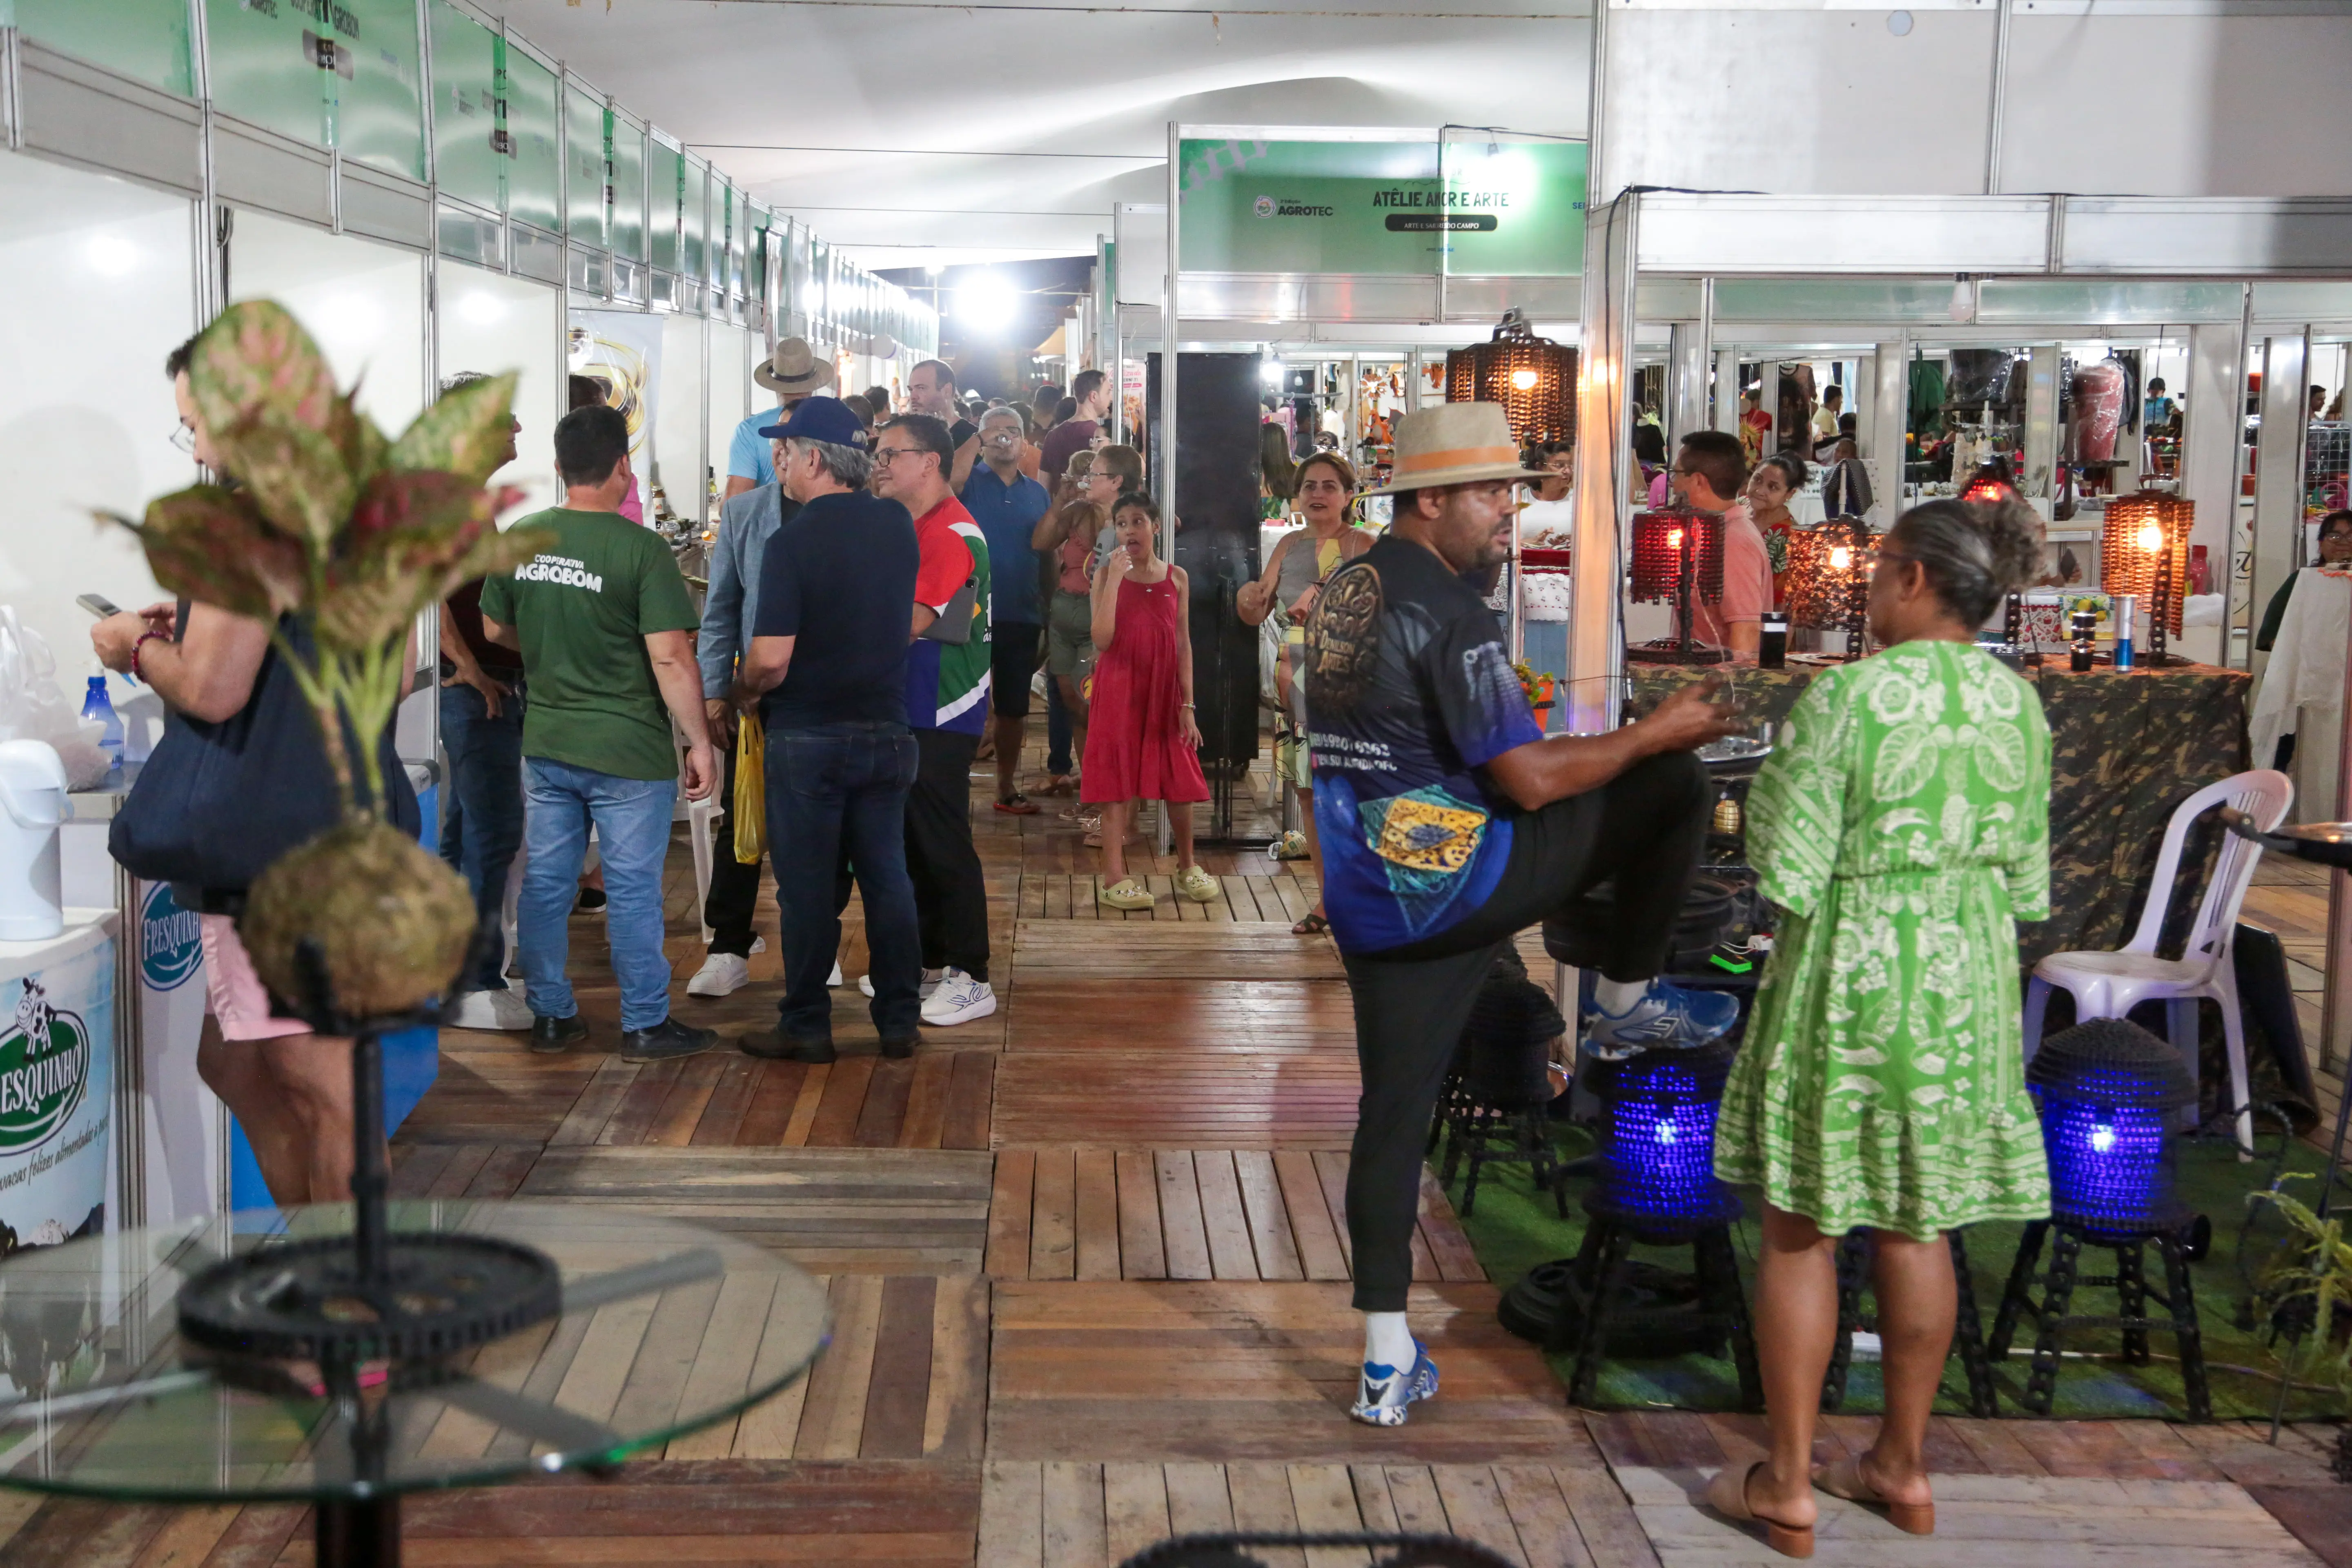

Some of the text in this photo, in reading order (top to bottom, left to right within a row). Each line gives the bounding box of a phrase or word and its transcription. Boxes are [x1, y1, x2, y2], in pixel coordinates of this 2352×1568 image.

[1277, 206, 1333, 216] AGROTEC
[1373, 187, 1510, 207] ATÊLIE AMOR E ARTE
[535, 554, 584, 569] COOPERATIVA
[515, 563, 602, 592] AGROBOM
[1319, 630, 1355, 655] DENILSON
[1316, 650, 1350, 679] ARTES
[144, 910, 200, 961] FRESQUINH
[0, 1045, 81, 1114] ESQUINHO
[0, 1167, 27, 1192] vacas
[28, 1147, 53, 1186] felizes
[55, 1119, 94, 1165] alimentadas
